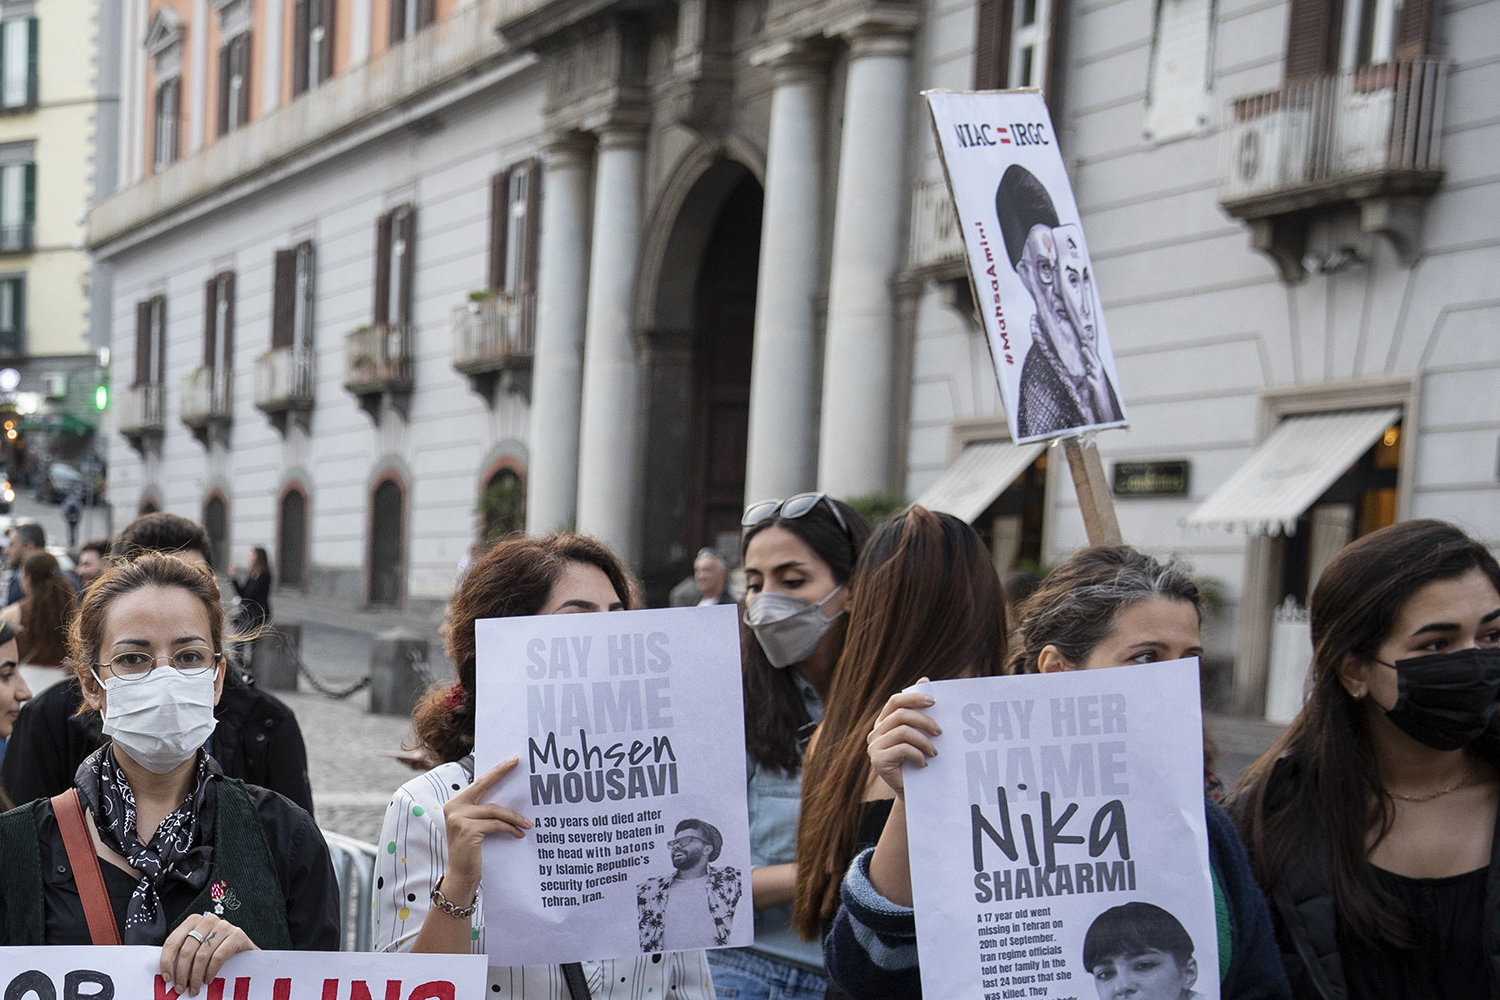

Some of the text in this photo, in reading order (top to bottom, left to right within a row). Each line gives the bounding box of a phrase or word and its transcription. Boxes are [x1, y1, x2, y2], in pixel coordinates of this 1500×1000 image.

[954, 123, 996, 147] NIAC
[1010, 123, 1049, 146] IRGC
[526, 631, 672, 680] SAY HIS
[526, 677, 674, 737] NAME
[961, 693, 1127, 744] SAY HER
[528, 729, 676, 774] Mohsen
[964, 741, 1130, 805] NAME
[529, 763, 679, 806] MOUSAVI
[535, 810, 661, 828] A 30 years old died after
[971, 784, 1131, 873] Nika
[536, 823, 664, 844] being severely beaten in
[538, 840, 654, 859] the head with batons
[539, 855, 649, 876] by Islamic Republic's
[541, 871, 627, 891] security forcesin
[974, 860, 1136, 903] SHAKARMI
[542, 891, 604, 907] Tehran, Iran.
[977, 907, 1050, 923] A 17 year old went
[978, 920, 1063, 936] missing in Tehran on
[980, 934, 1056, 949] 20th of September.
[980, 946, 1062, 962] Iran regime officials
[982, 959, 1065, 975] told her family in the
[983, 971, 1071, 988] last 24 hours that she
[984, 987, 1047, 1000] was killed. They
